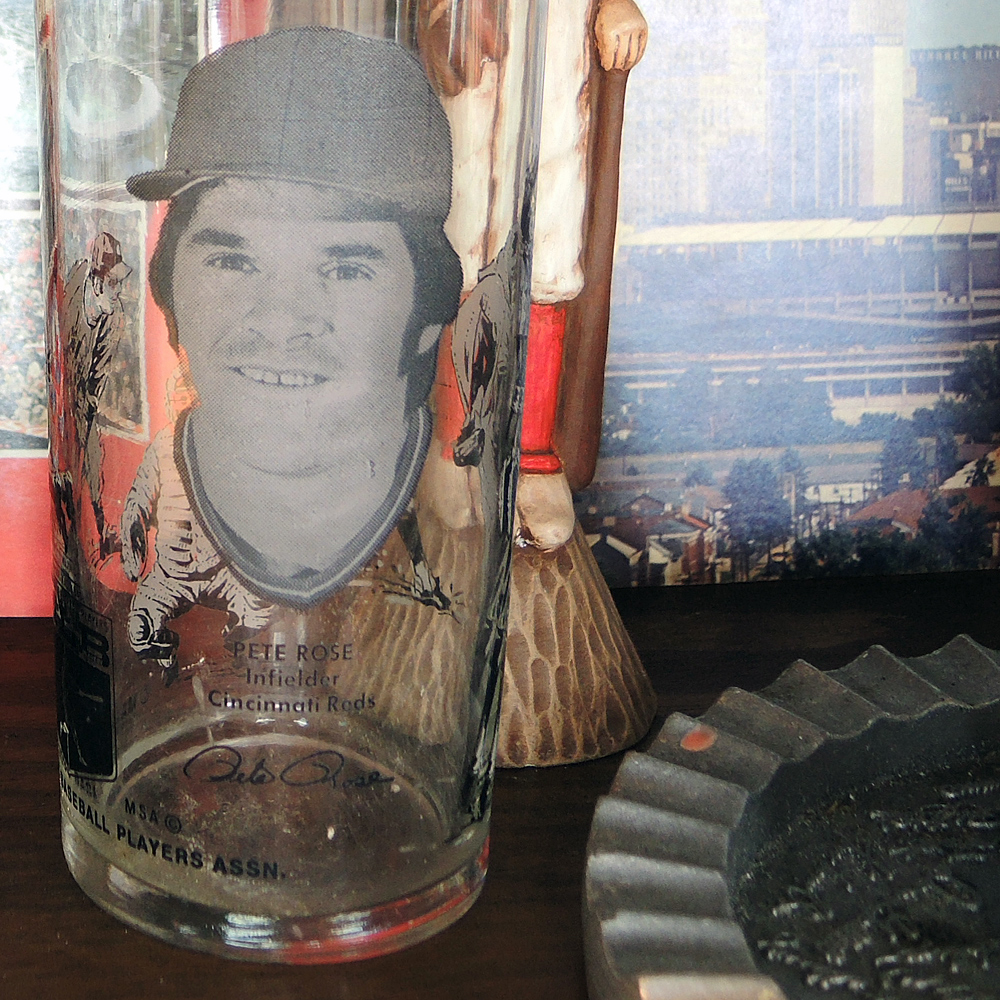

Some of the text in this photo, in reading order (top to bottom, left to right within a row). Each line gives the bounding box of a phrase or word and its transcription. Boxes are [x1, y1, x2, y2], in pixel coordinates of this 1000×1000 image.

[233, 642, 353, 662] PETE ROSE
[246, 668, 340, 687] Infielder
[208, 689, 319, 712] Cincinnati
[124, 797, 159, 825] MSA
[116, 823, 204, 869] PLAYERS
[212, 855, 286, 880] ASSN.
